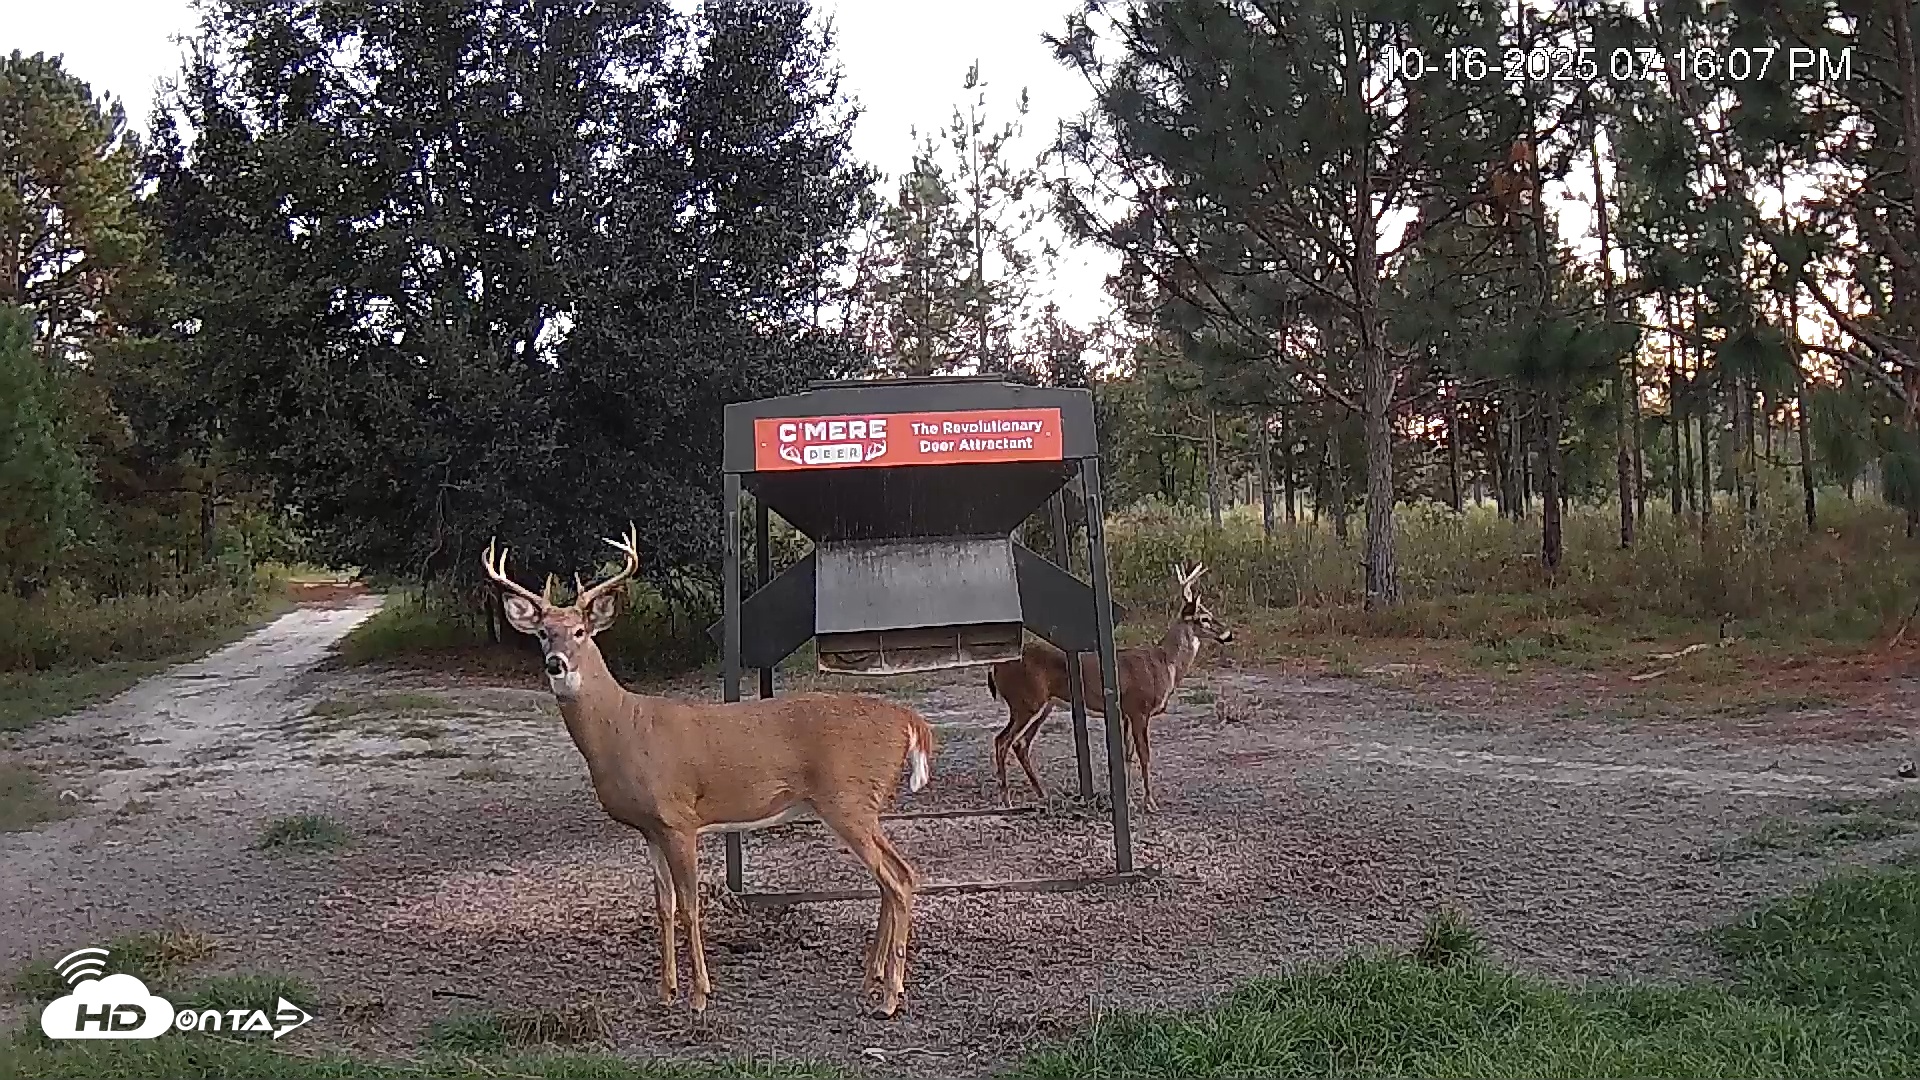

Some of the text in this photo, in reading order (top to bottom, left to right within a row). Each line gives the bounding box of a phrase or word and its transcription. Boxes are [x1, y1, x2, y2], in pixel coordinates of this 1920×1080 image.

[779, 419, 887, 442] C'MERE
[911, 420, 1043, 435] The Revolutionary
[920, 437, 1033, 453] Deer Attractant
[809, 447, 859, 460] DEER
